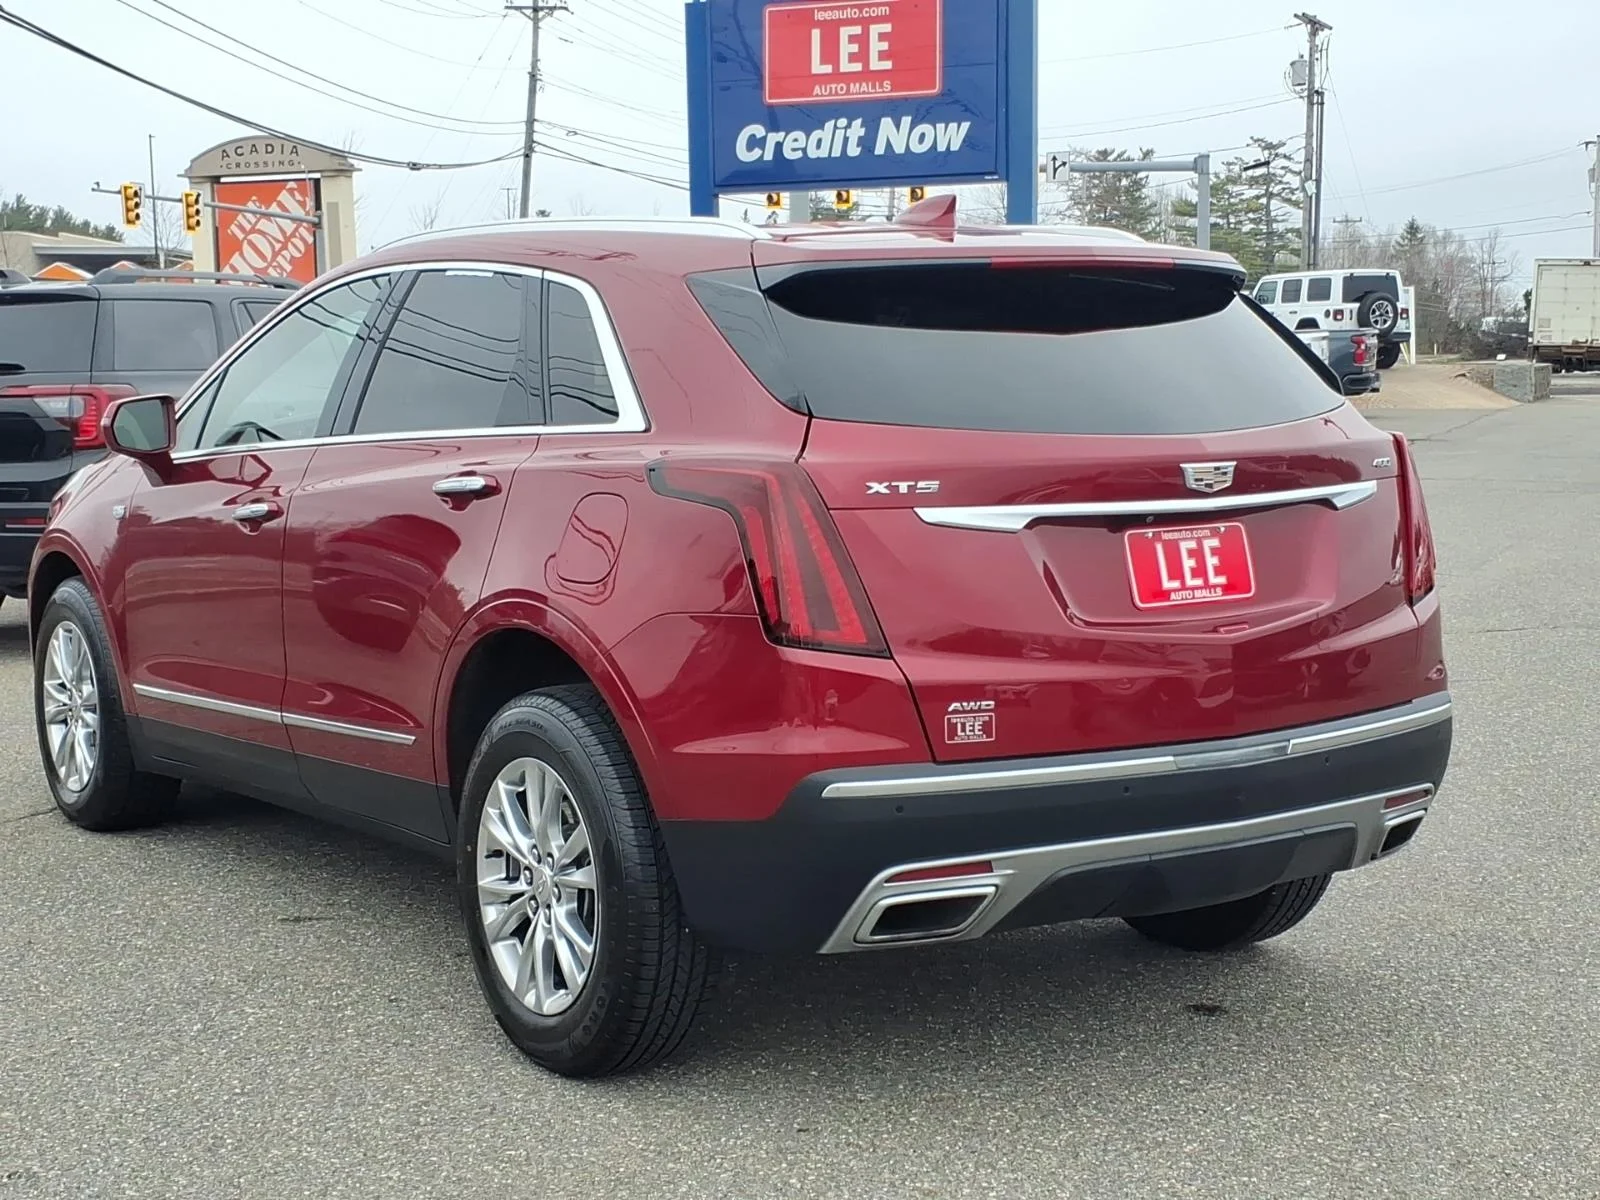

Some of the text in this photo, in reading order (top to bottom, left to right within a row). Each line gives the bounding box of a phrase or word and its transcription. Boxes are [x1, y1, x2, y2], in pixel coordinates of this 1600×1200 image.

[814, 6, 890, 20] leeauto.com
[811, 23, 892, 74] LEE
[813, 80, 892, 97] AUTO MALLS
[735, 115, 971, 162] Credit Now
[221, 143, 300, 161] ACADIA
[225, 159, 295, 170] CROSSING
[227, 195, 265, 241] THE
[221, 182, 310, 281] HOME
[266, 221, 315, 278] EPOT
[1161, 529, 1211, 540] leeauto.com
[1154, 538, 1228, 590] LEE
[1170, 587, 1223, 600] AUTO MALLS
[947, 701, 995, 711] AWD
[957, 721, 983, 736] LEE
